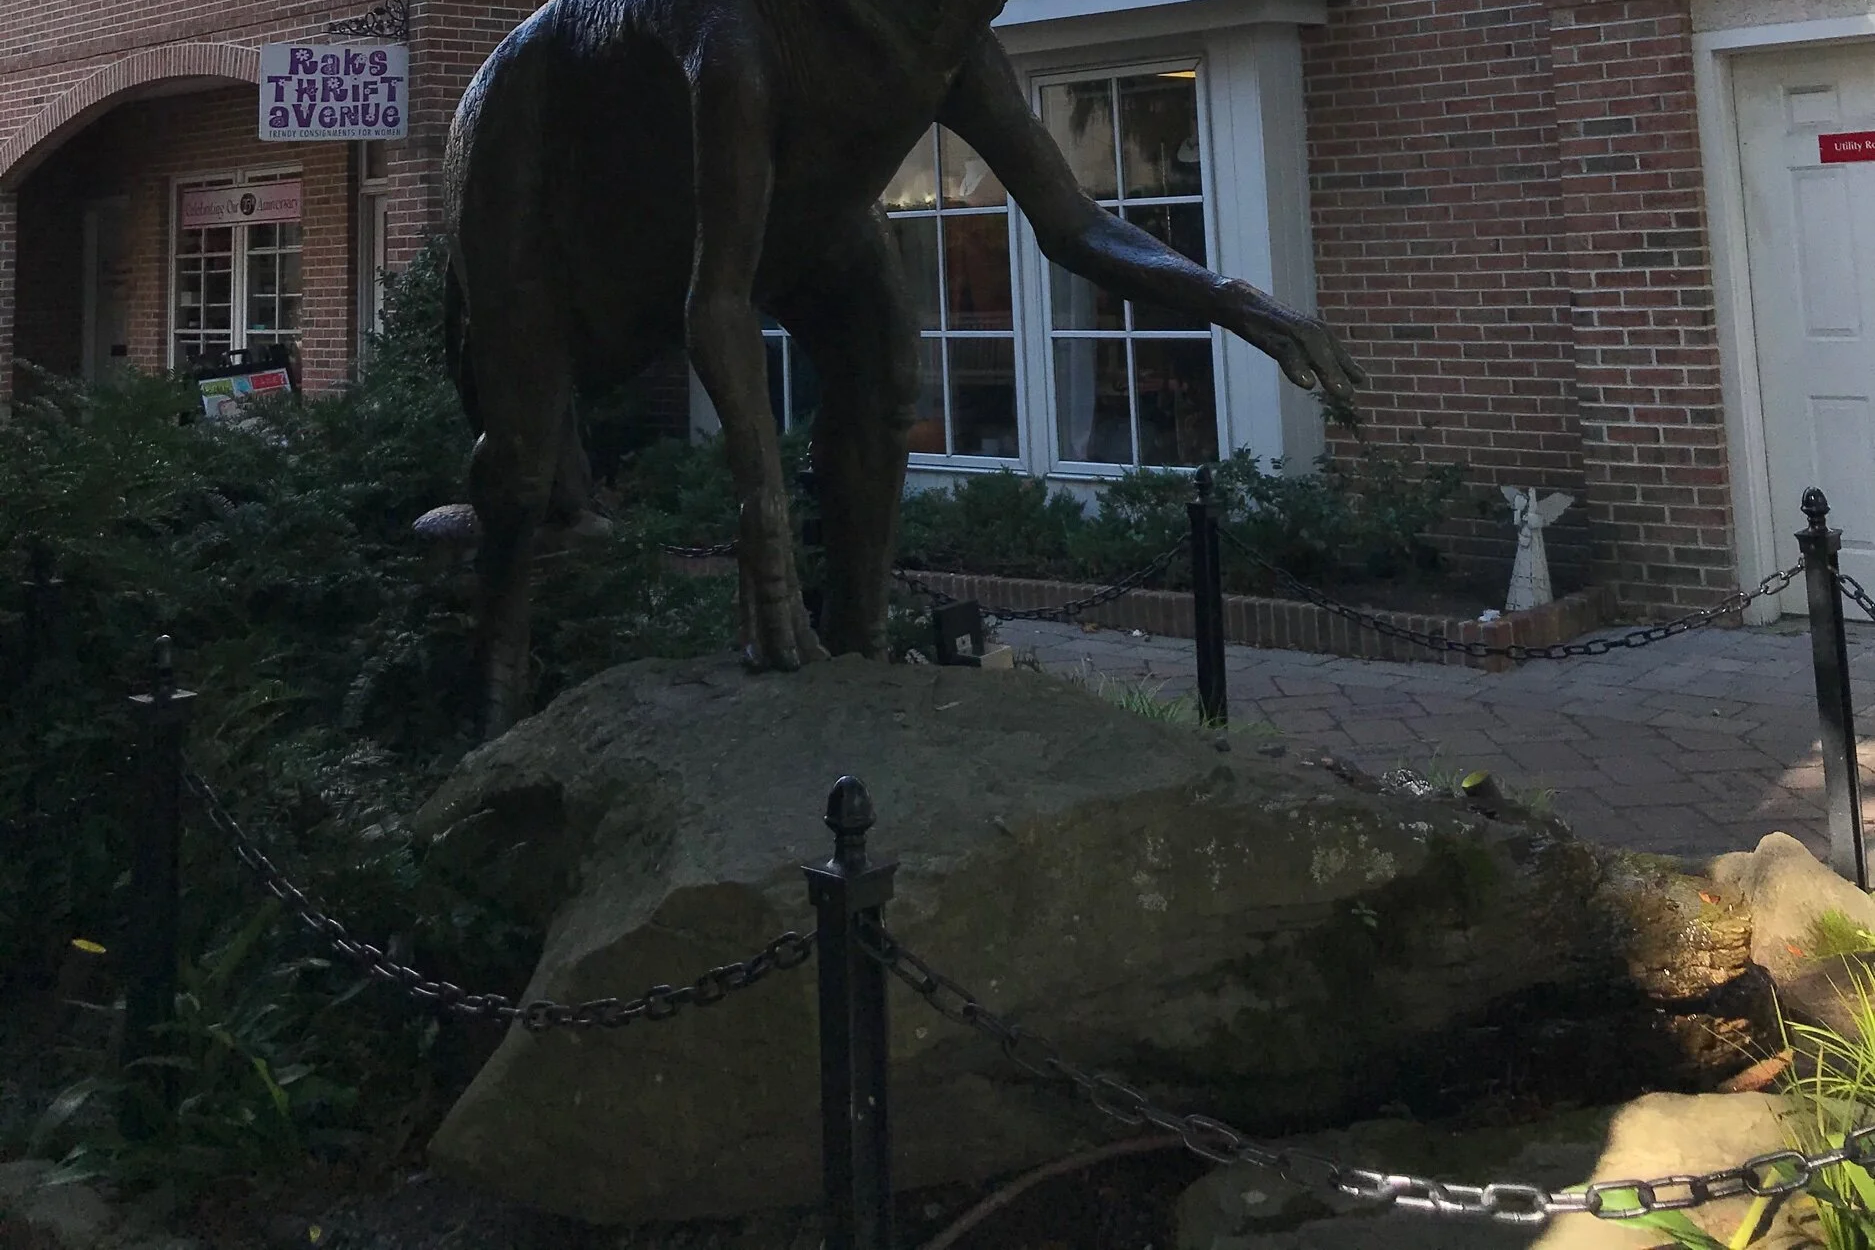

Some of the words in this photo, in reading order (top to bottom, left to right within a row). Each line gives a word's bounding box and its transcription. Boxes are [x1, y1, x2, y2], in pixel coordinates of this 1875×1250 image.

[289, 48, 388, 76] Raks
[269, 129, 297, 138] TRENDY
[299, 129, 355, 138] CONSIGNMENTS
[358, 129, 371, 137] FOR
[374, 128, 401, 136] WOMEN
[1834, 141, 1863, 152] Utility
